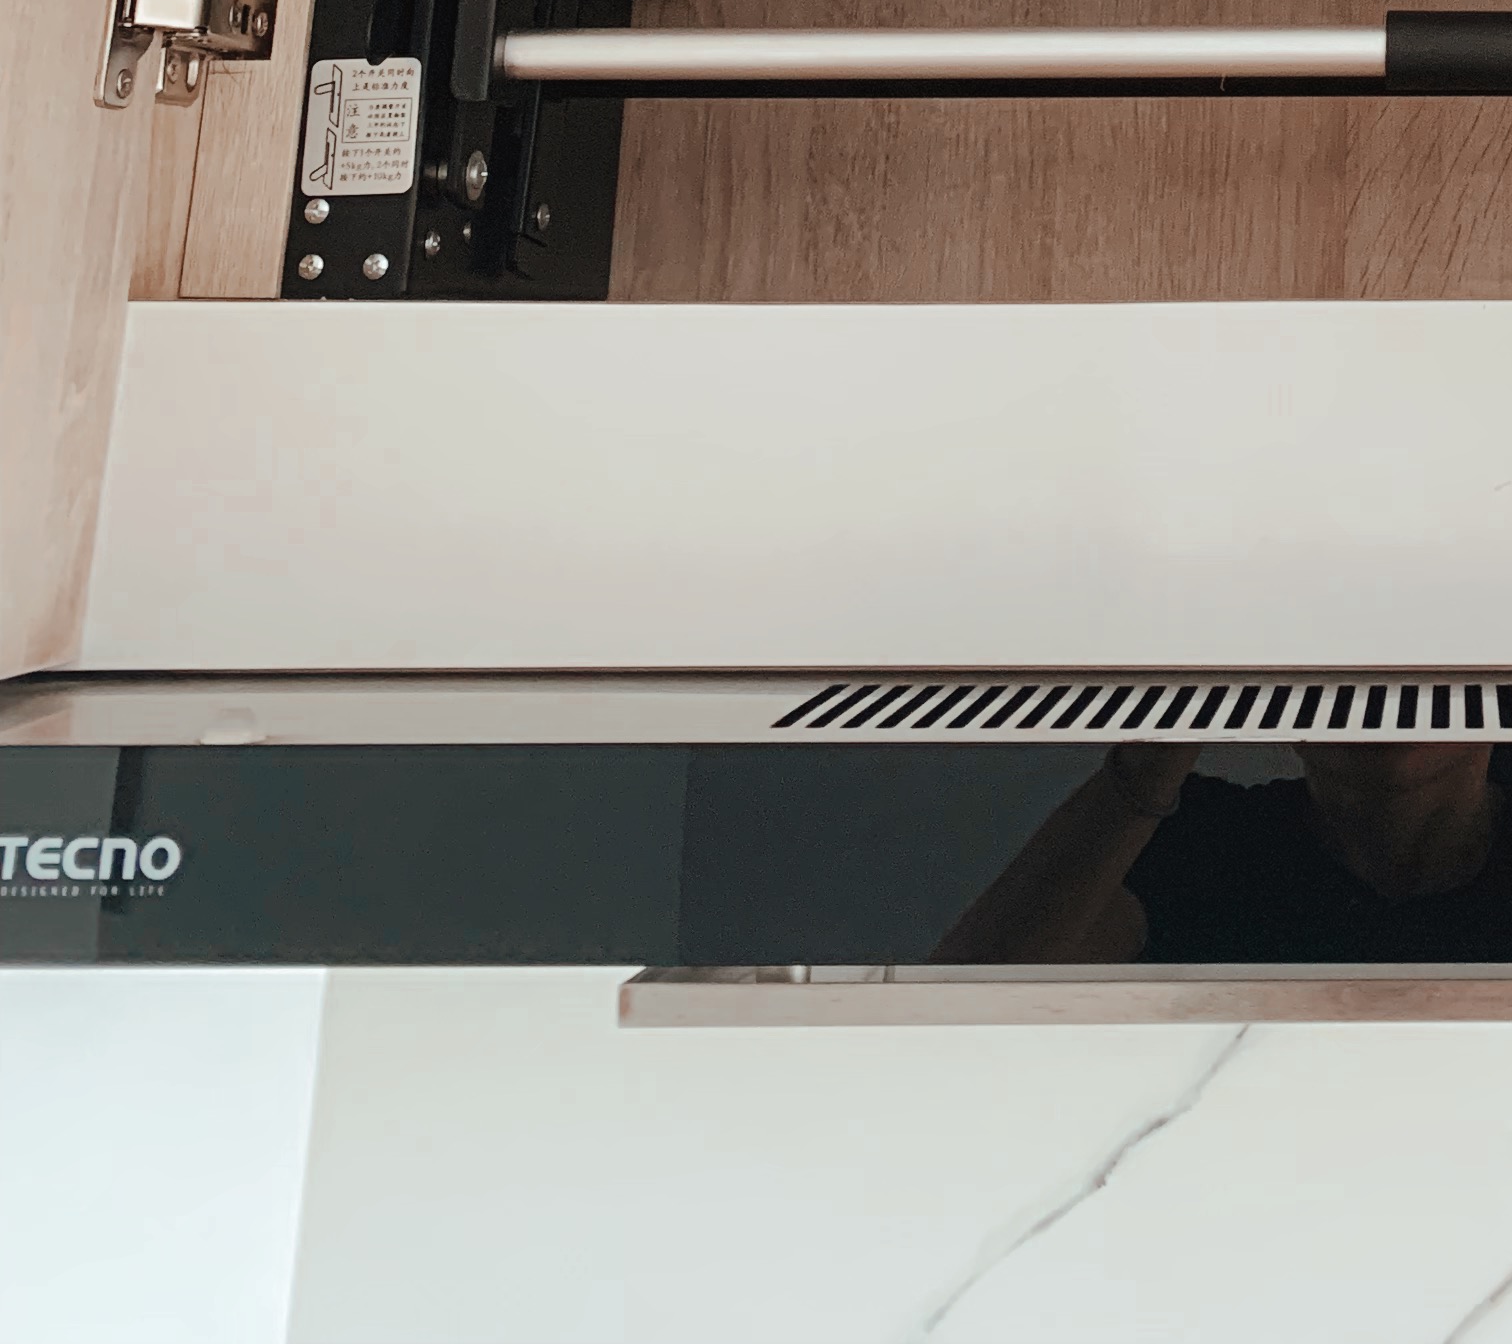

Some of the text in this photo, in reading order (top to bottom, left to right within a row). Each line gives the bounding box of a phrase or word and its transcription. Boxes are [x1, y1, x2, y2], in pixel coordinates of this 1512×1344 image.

[0, 836, 182, 881] TECNO
[0, 885, 164, 897] DESIGNED FOR LIFE
